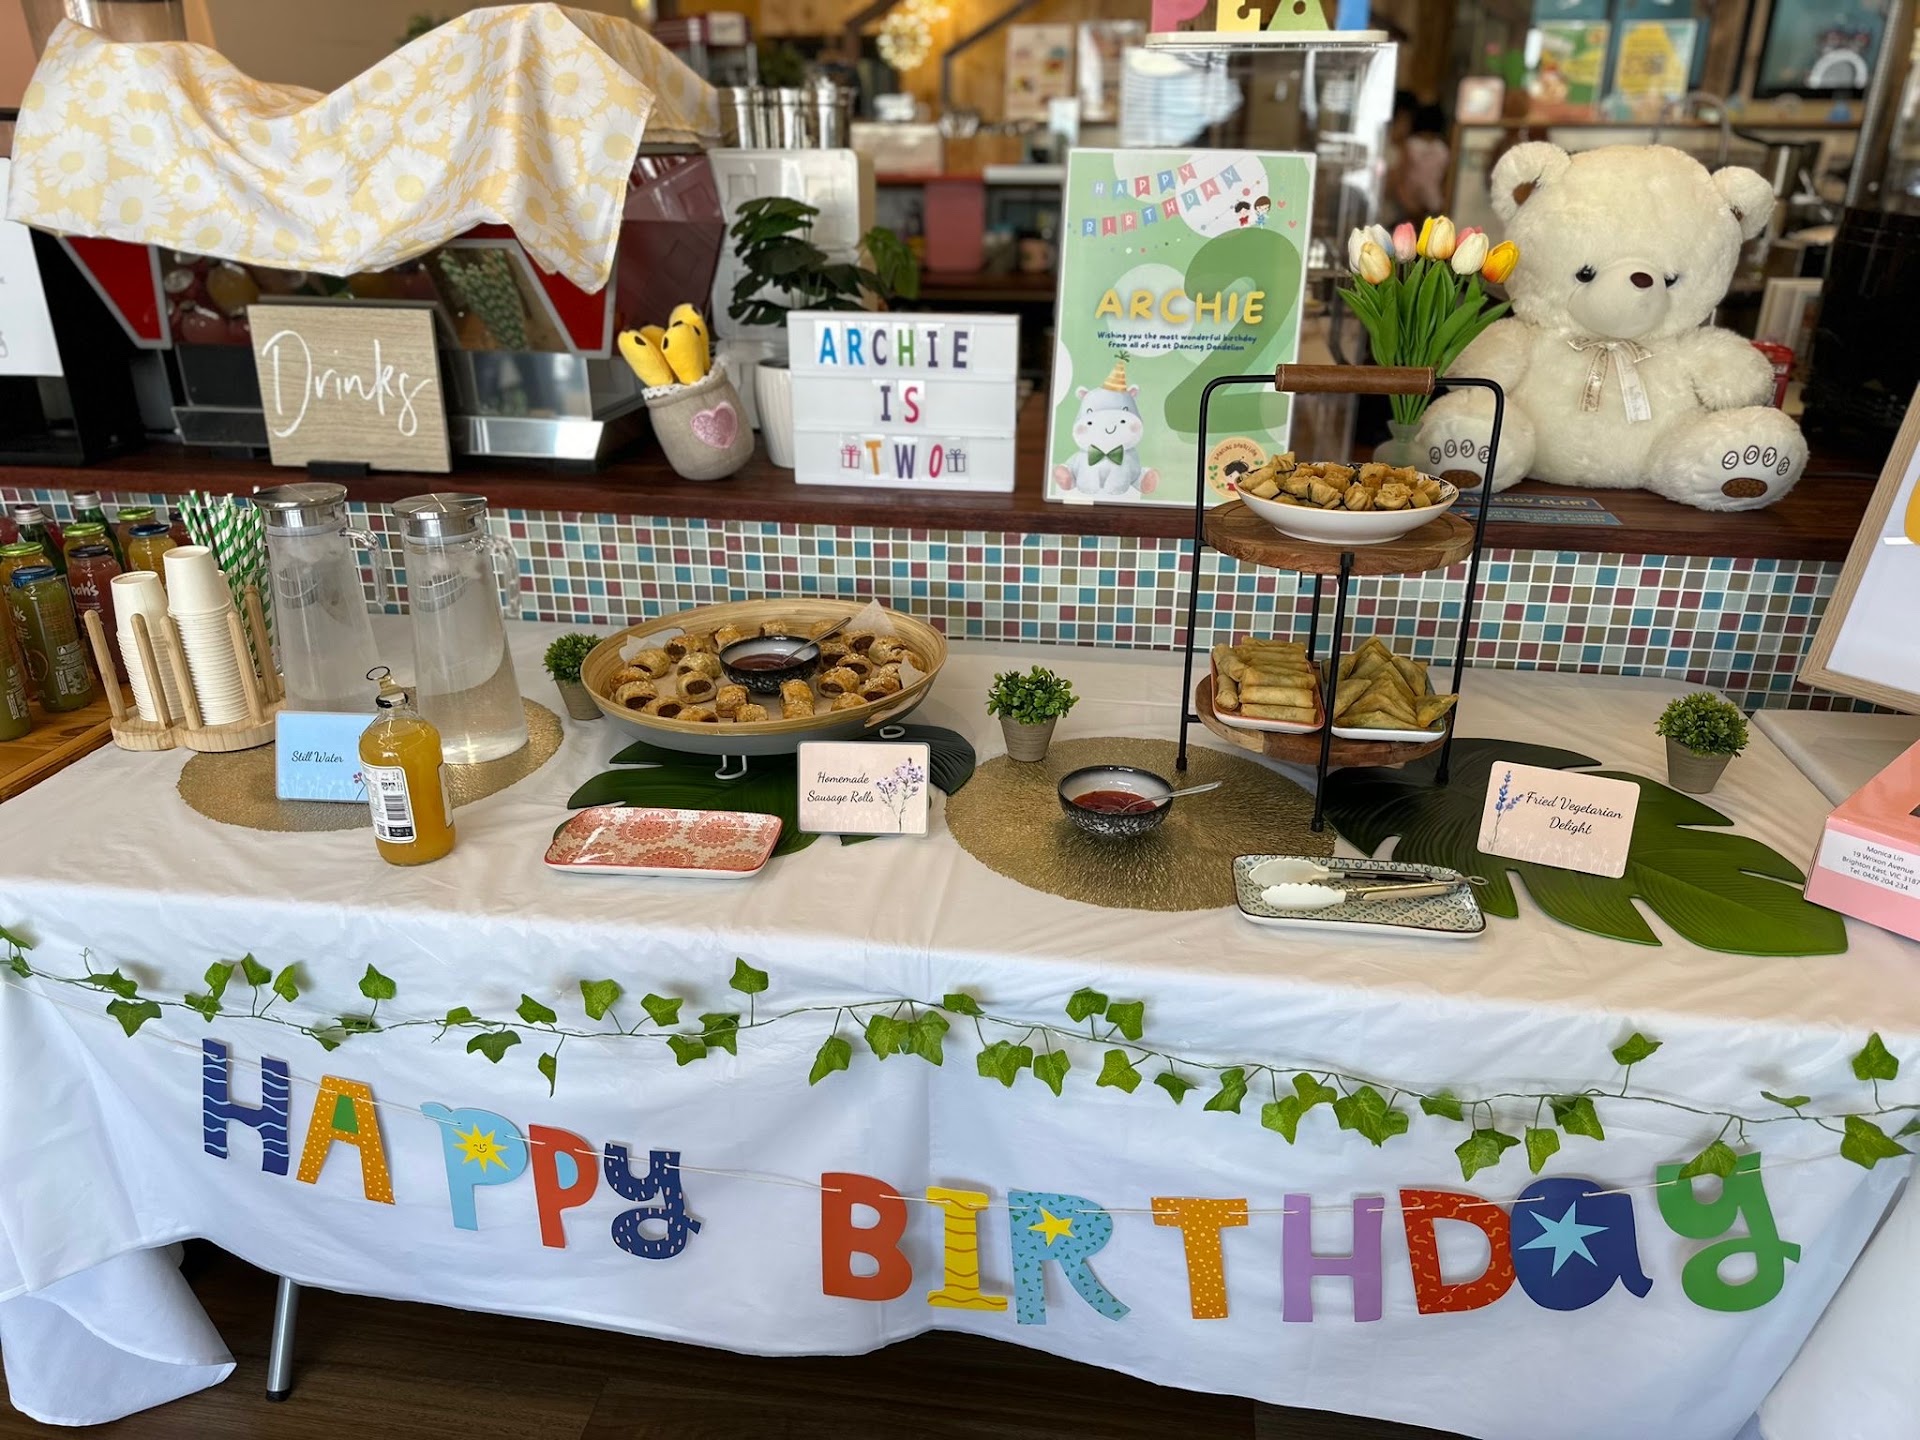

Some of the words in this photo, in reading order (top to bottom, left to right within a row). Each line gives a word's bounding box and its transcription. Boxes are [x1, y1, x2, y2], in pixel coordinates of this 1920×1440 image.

[1094, 165, 1194, 196] HAPPY
[1084, 170, 1237, 234] BIRTHDAY
[1095, 288, 1266, 325] ARCHIE
[819, 327, 969, 369] ARCHIE
[1097, 331, 1127, 340] Wishing
[1129, 334, 1142, 342] you
[1144, 332, 1157, 340] the
[1181, 333, 1221, 341] wonderful
[1223, 333, 1257, 344] birthday
[1140, 341, 1149, 349] of
[1173, 342, 1205, 352] Dancing
[1206, 343, 1245, 351] Dandelion
[262, 330, 433, 438] Drinks
[880, 385, 920, 424] IS
[865, 439, 943, 479] TWO
[1722, 446, 1790, 475] LOVE
[1463, 496, 1534, 504] ALERGY
[71, 580, 99, 597] oah's
[291, 750, 314, 763] Still
[314, 750, 344, 763] Water
[817, 771, 870, 784] Homemade
[807, 789, 848, 805] Sausage
[850, 790, 874, 803] Rolls
[1526, 791, 1559, 807] Fried
[1560, 796, 1623, 819] Vegetarian
[1549, 816, 1592, 835] Delight
[1866, 846, 1892, 859] Monica
[1842, 856, 1871, 871] Brighton
[1889, 871, 1902, 879] VIC
[1903, 877, 1920, 885] 3187
[1862, 854, 1886, 866] Wrixon
[1887, 862, 1914, 875] Avenue
[1862, 872, 1879, 881] 0426
[1880, 878, 1894, 886] 204
[1895, 882, 1909, 891] 234
